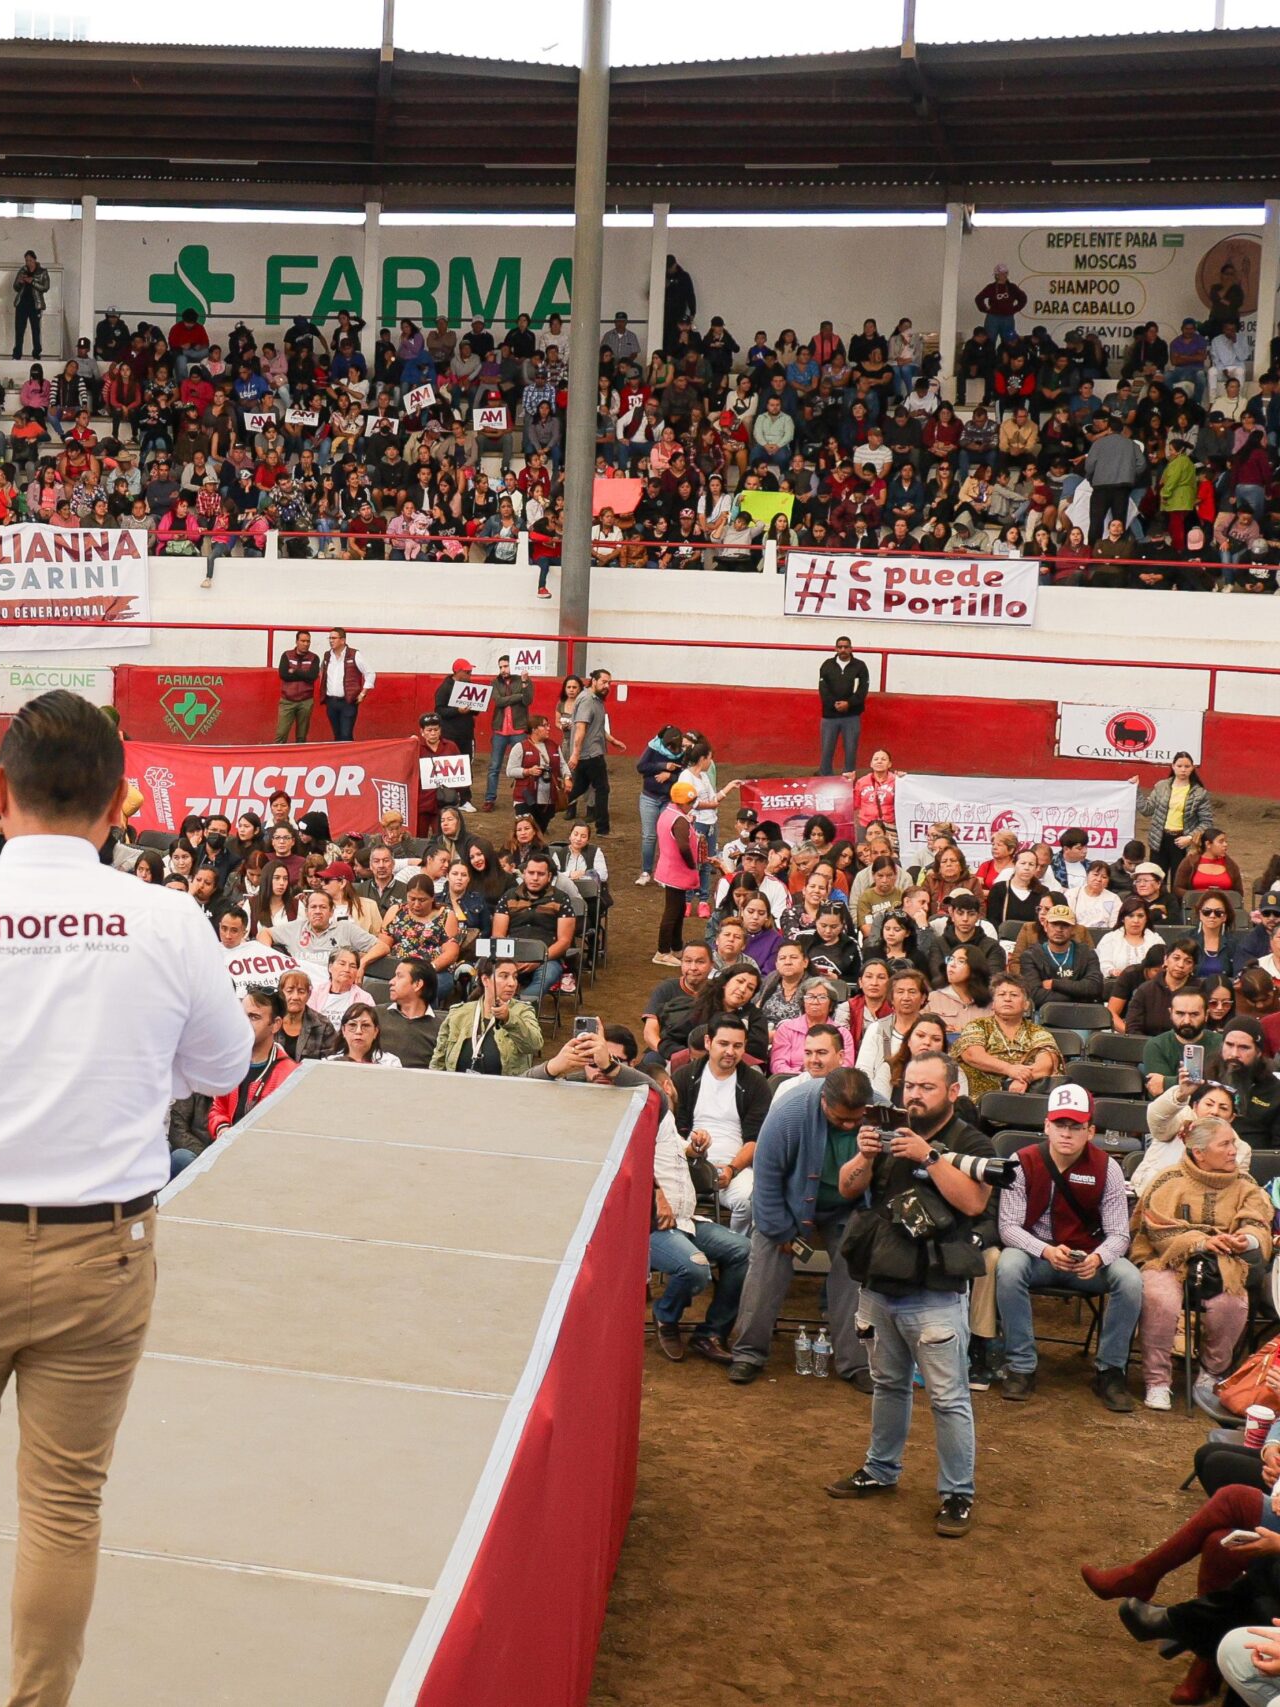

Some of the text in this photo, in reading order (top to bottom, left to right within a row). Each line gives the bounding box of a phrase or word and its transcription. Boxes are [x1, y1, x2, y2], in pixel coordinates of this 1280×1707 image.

[1047, 232, 1157, 248] REPELENTE PARA
[1075, 255, 1137, 269] MOSCAS
[1050, 279, 1120, 295] SHAMPOO
[1034, 302, 1135, 315] PARA CABALLO
[481, 410, 503, 422] AM
[849, 560, 872, 583] C
[883, 563, 1004, 589] puede
[847, 588, 1027, 618] R Portillo
[14, 604, 106, 619] GENERACIONAL
[515, 650, 541, 665] AM
[10, 672, 96, 687] BACCUNE
[157, 674, 223, 686] FARMACIA
[458, 686, 488, 703] AM
[1076, 744, 1172, 760] CARNICERI
[430, 758, 465, 778] AM
[212, 765, 365, 797] VICTOR
[429, 777, 466, 785] PROYECTO
[760, 793, 815, 802] VICTOR
[761, 800, 814, 808] ZURITA
[912, 823, 987, 841] FRZA
[65, 943, 79, 953] de
[84, 940, 130, 953] México
[228, 955, 300, 976] orena
